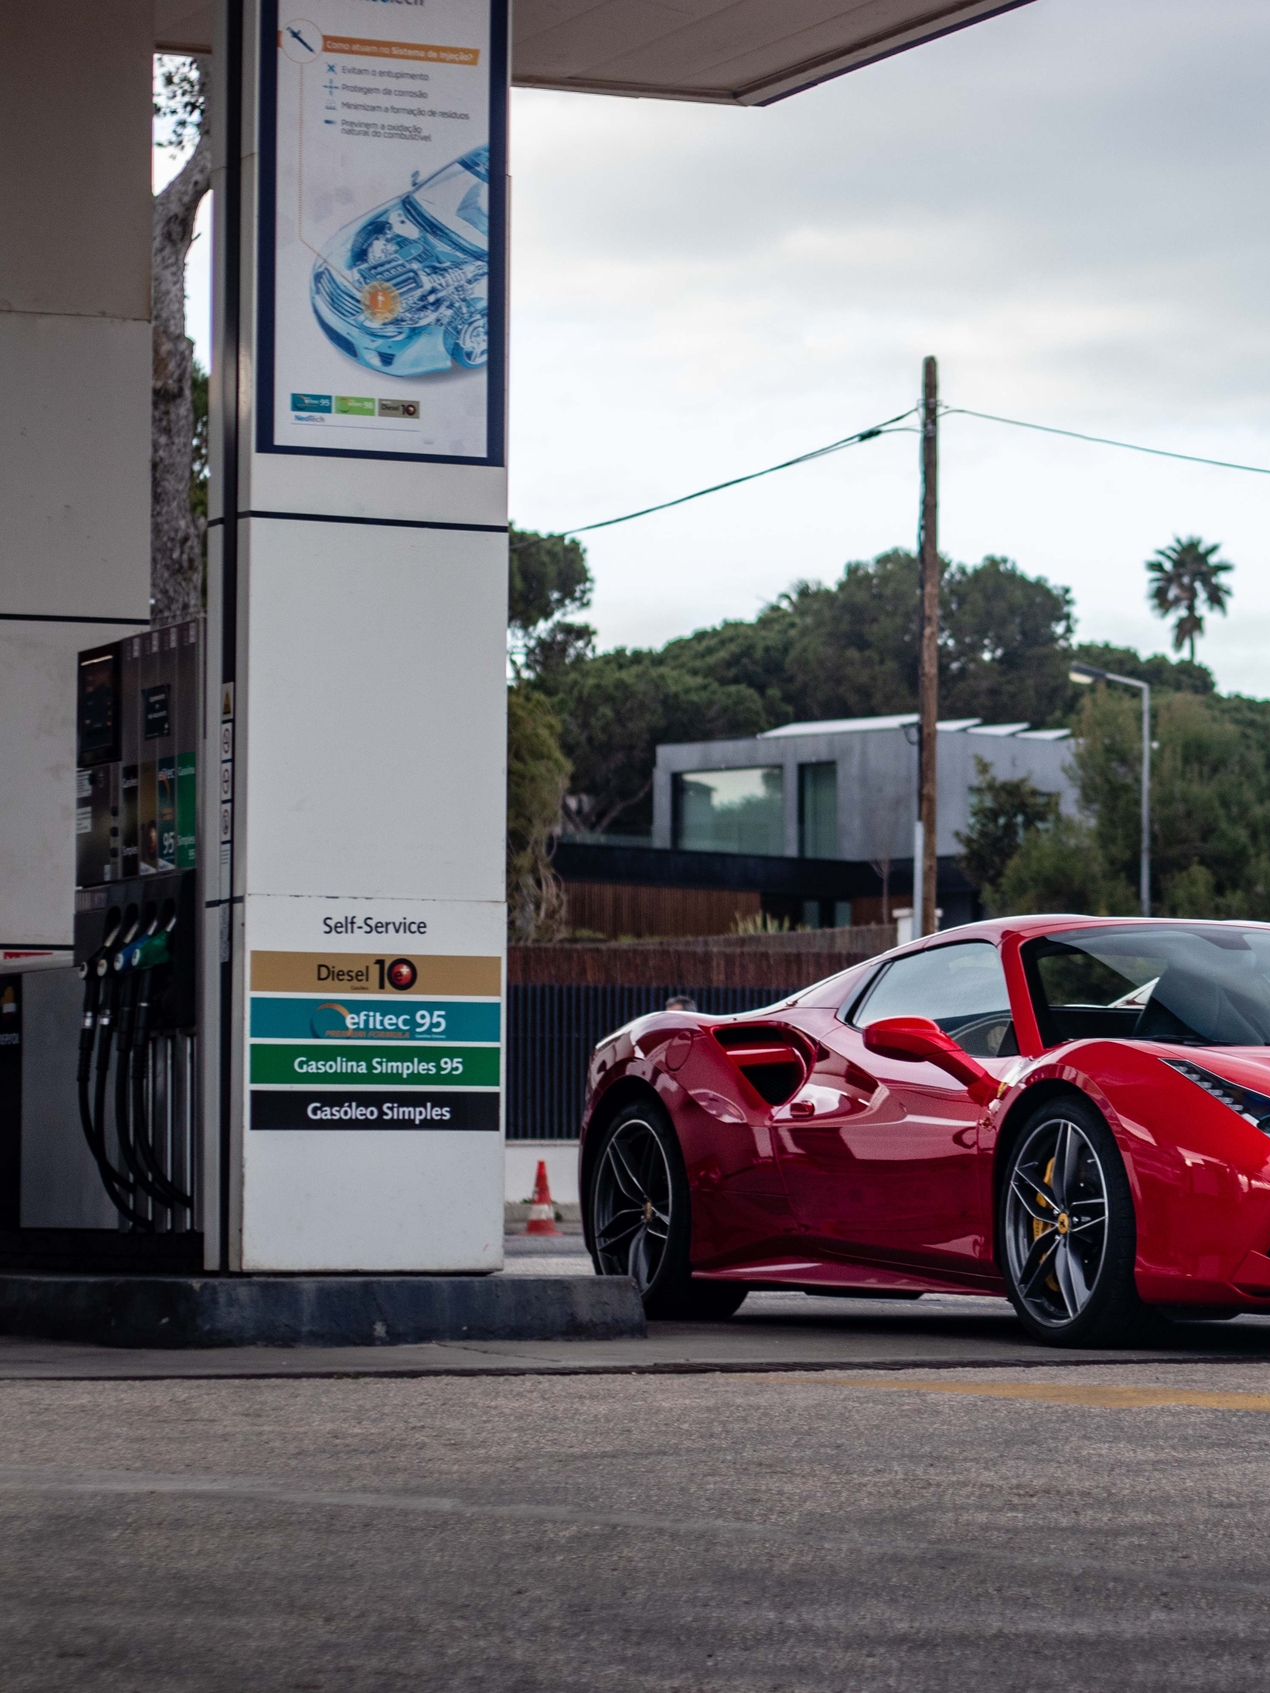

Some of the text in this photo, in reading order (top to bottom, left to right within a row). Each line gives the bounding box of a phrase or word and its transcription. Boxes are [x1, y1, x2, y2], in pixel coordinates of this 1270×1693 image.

[326, 40, 350, 51] Como
[391, 46, 425, 58] Sistema
[427, 50, 438, 58] de
[341, 65, 370, 76] Evitam
[379, 69, 429, 81] entupimento
[341, 83, 380, 96] Protegem
[394, 88, 428, 99] corrosão
[341, 101, 382, 113] Minimizam
[390, 105, 426, 117] formação
[427, 109, 438, 117] de
[439, 109, 470, 120] resíduos
[341, 119, 379, 129] Previnem
[387, 123, 422, 134] oxidação
[341, 128, 431, 142] natural do combustível
[320, 399, 330, 407] 95
[323, 916, 427, 935] Self-Service
[317, 964, 369, 982] Diesel
[345, 1010, 446, 1033] efitec 95
[294, 1057, 463, 1078] Gasolina Simples 95
[307, 1102, 451, 1124] Gasóleo Simples
